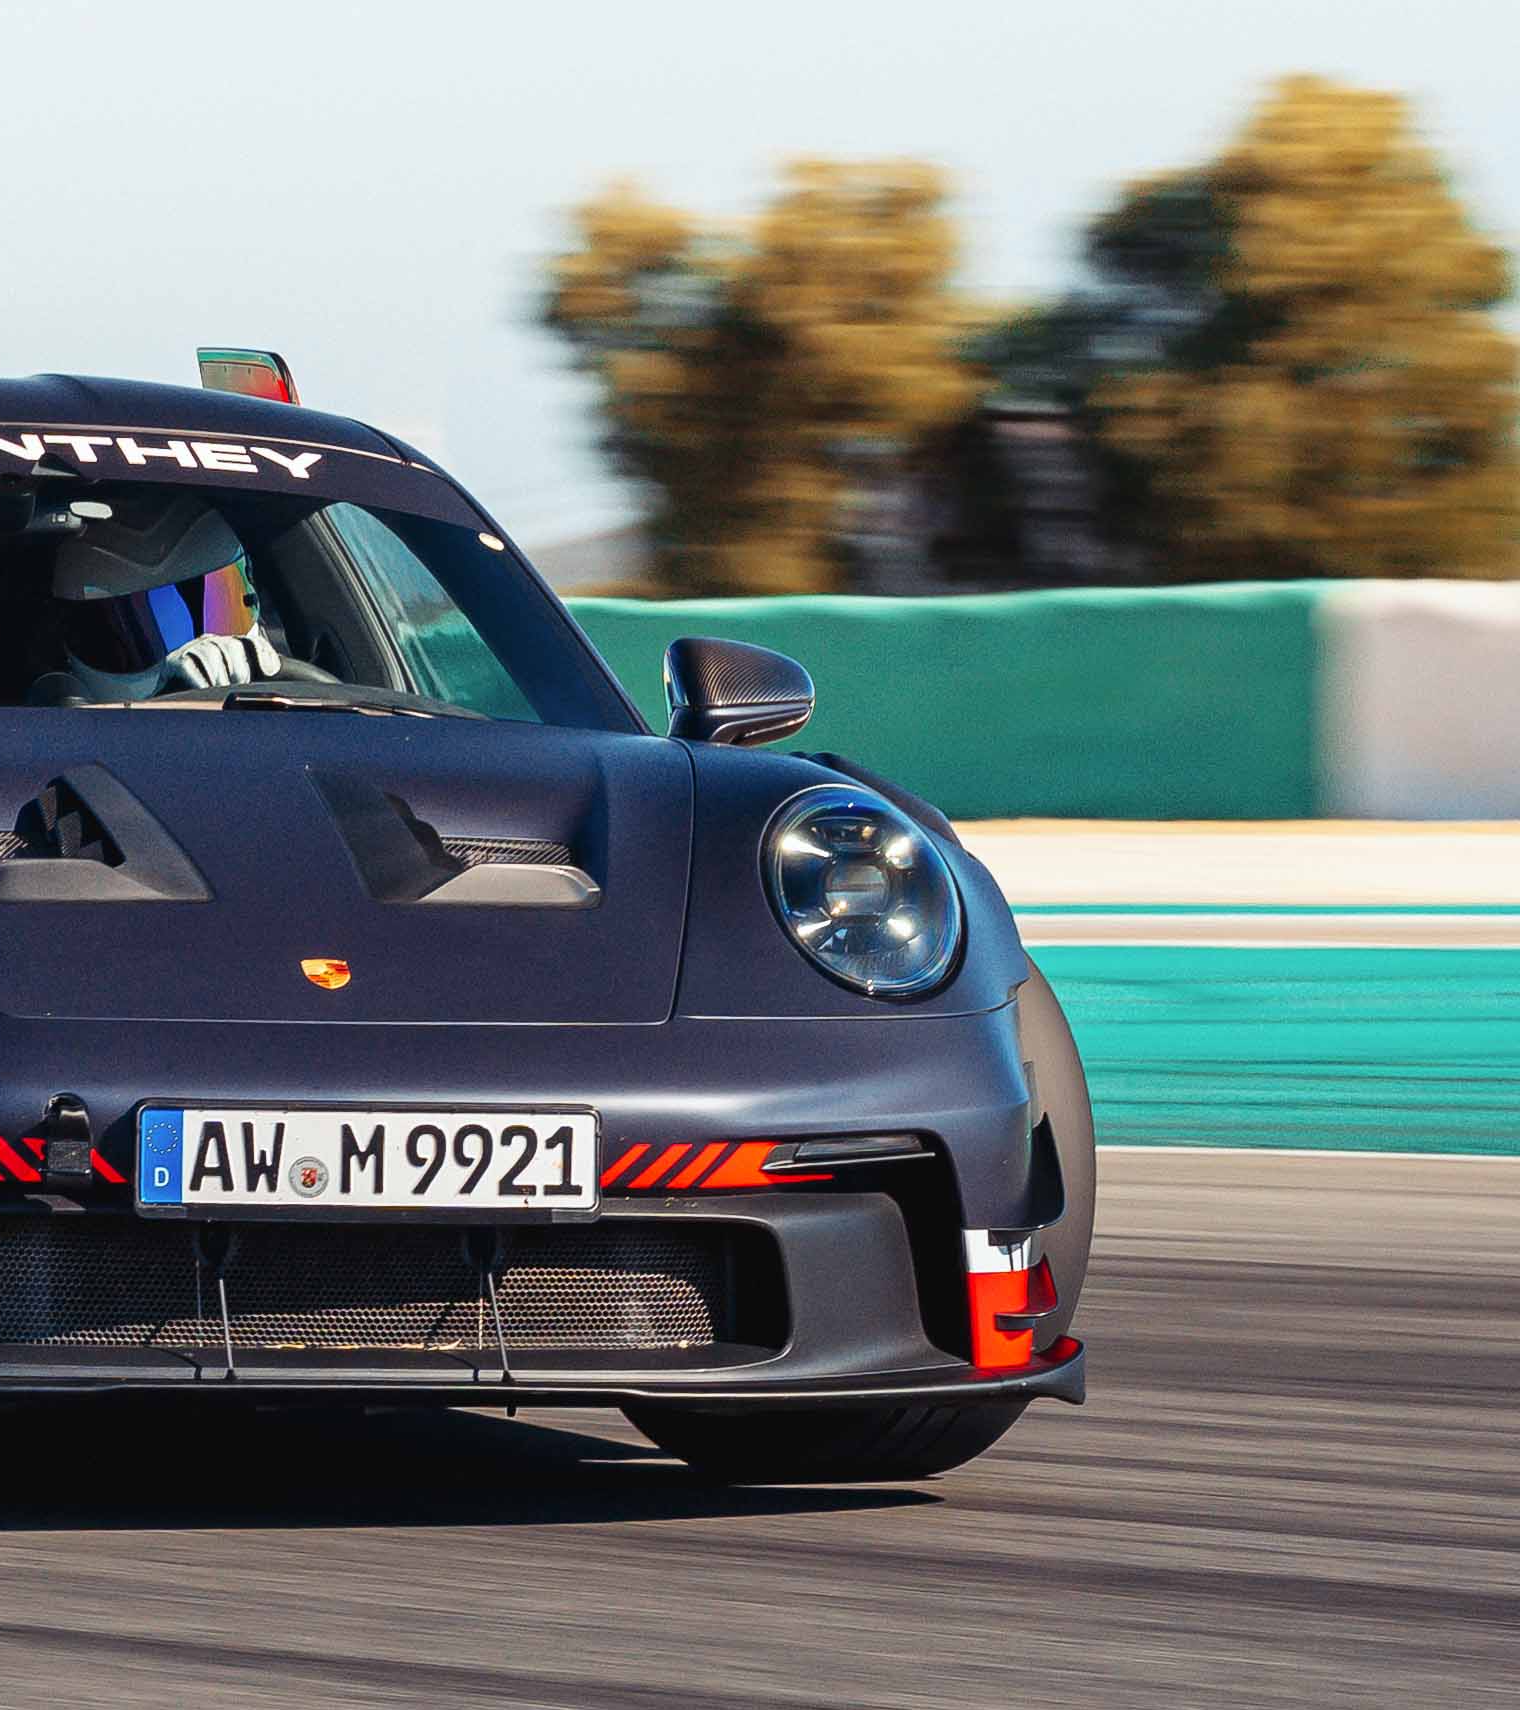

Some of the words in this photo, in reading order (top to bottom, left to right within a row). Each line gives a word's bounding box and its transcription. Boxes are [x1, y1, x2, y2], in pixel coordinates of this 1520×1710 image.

[153, 1167, 170, 1187] D
[189, 1120, 285, 1192] AW
[340, 1123, 385, 1194] M
[406, 1124, 583, 1196] 9921
